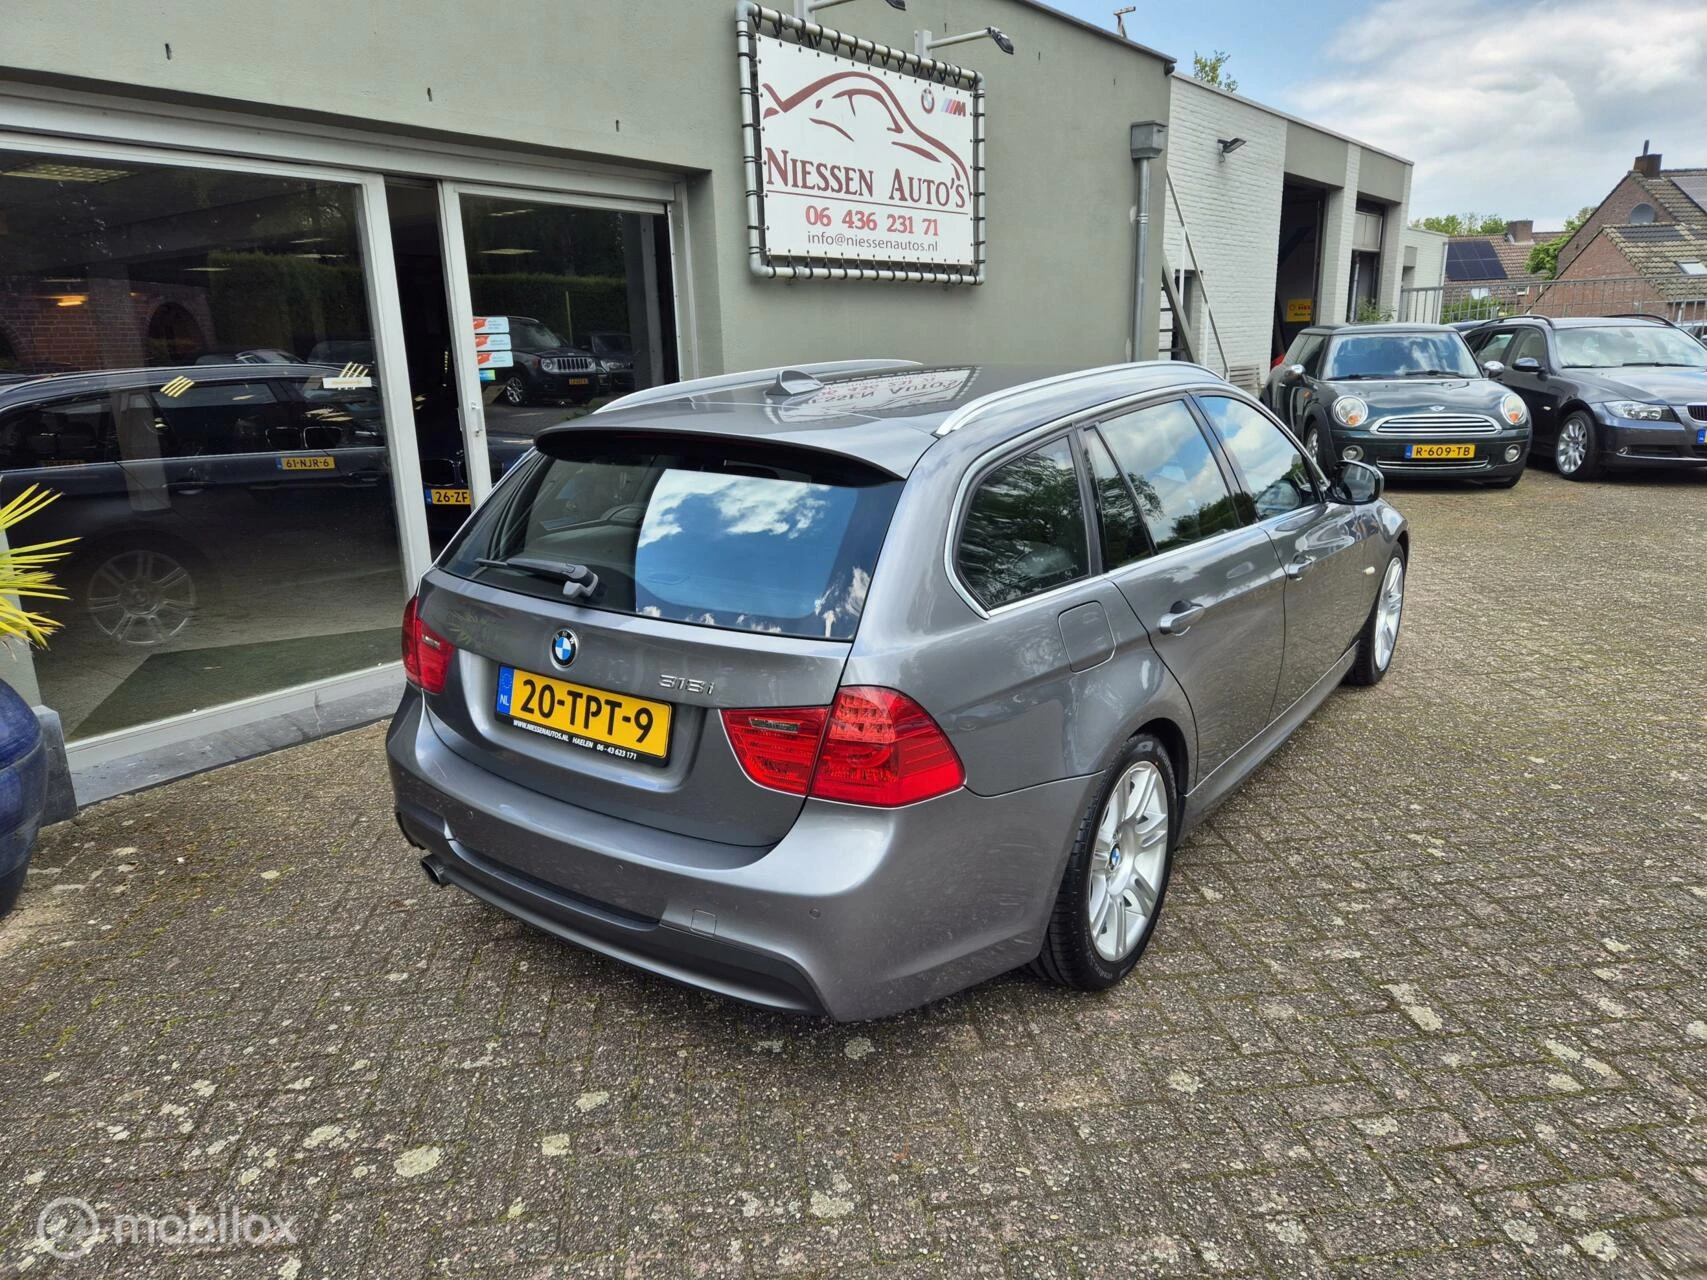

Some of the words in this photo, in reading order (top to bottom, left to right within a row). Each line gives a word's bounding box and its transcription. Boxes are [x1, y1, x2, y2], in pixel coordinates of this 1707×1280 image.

[765, 147, 874, 197] NIESSEN
[889, 168, 965, 208] AUTO'S
[805, 205, 832, 227] 06
[841, 209, 878, 231] 436
[886, 213, 914, 234] 231
[922, 218, 938, 236] 71
[807, 231, 938, 252] info@niessenautos.nl
[1415, 446, 1471, 457] R-609-TB
[286, 458, 330, 468] 61-NJR-6
[499, 694, 510, 706] NL
[520, 679, 654, 743] 20-TPT-9
[572, 736, 594, 749] HAELEN
